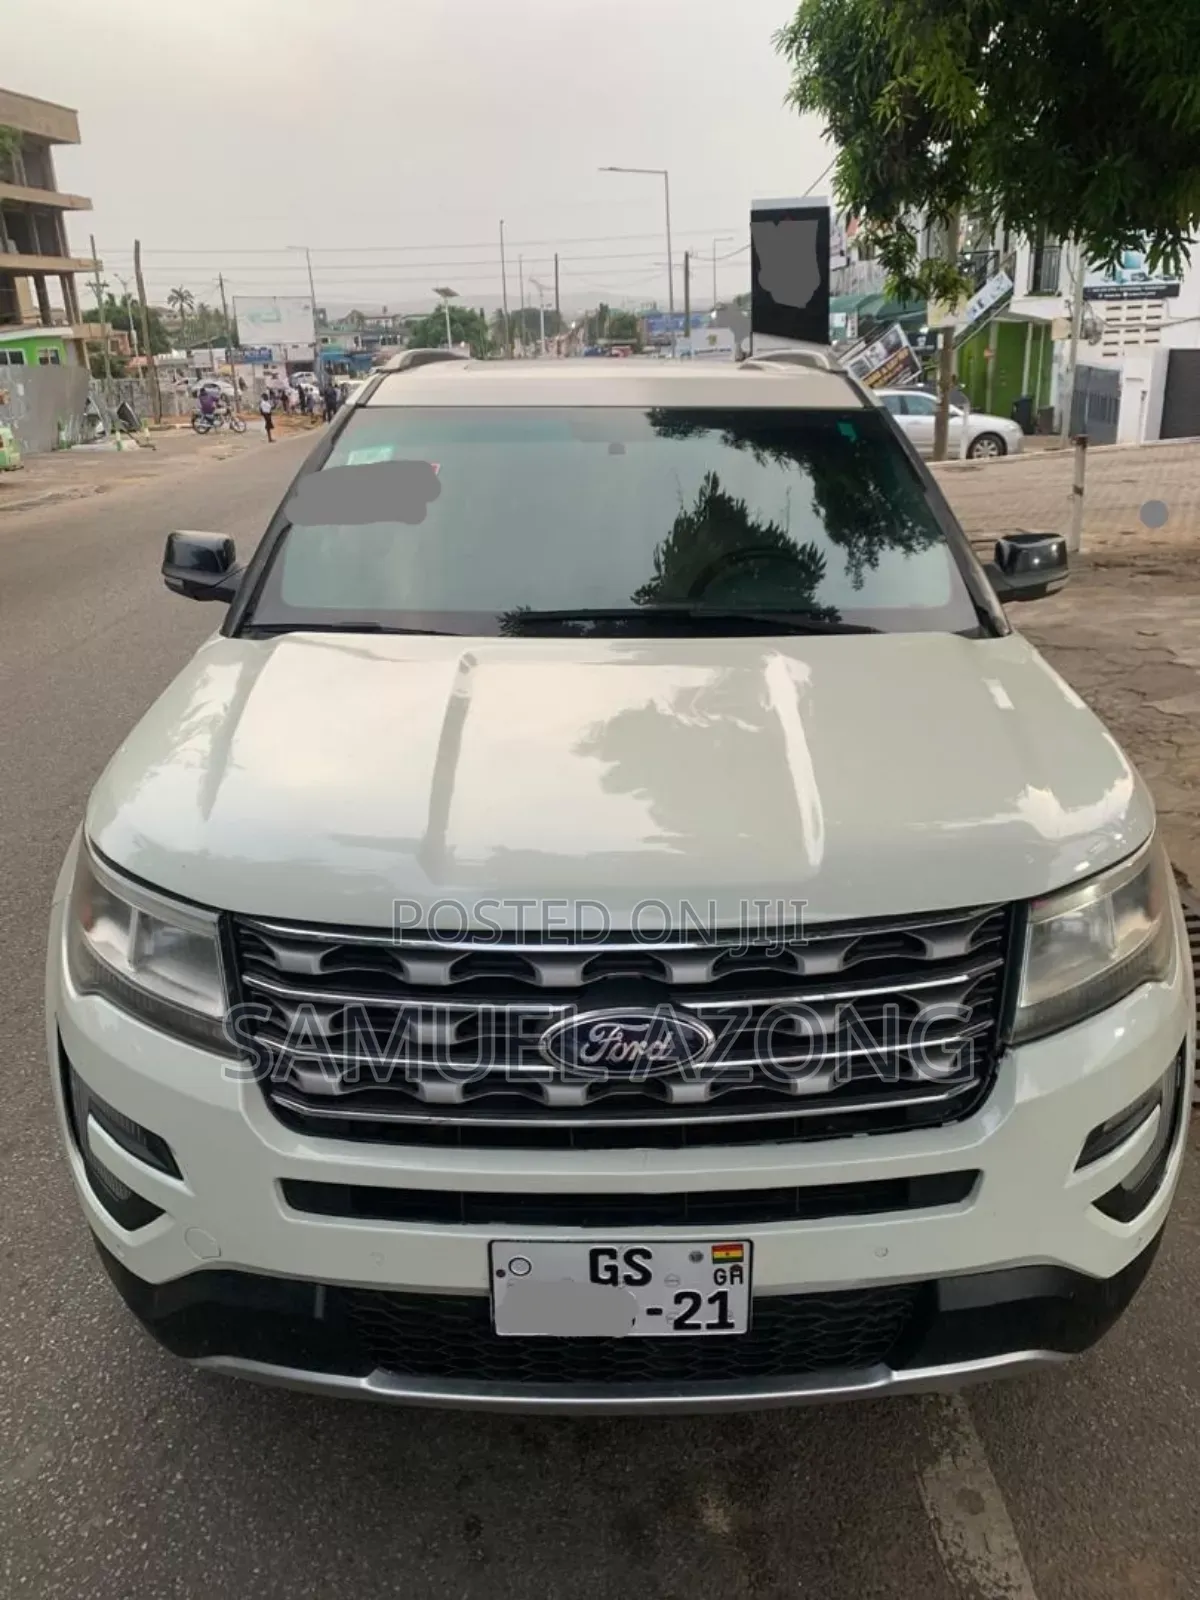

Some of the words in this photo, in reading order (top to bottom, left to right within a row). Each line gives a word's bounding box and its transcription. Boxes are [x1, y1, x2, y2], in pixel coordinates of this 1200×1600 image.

[579, 1022, 675, 1065] Ford
[588, 1246, 653, 1287] GS
[713, 1265, 743, 1286] GA
[631, 1290, 735, 1331] -21
